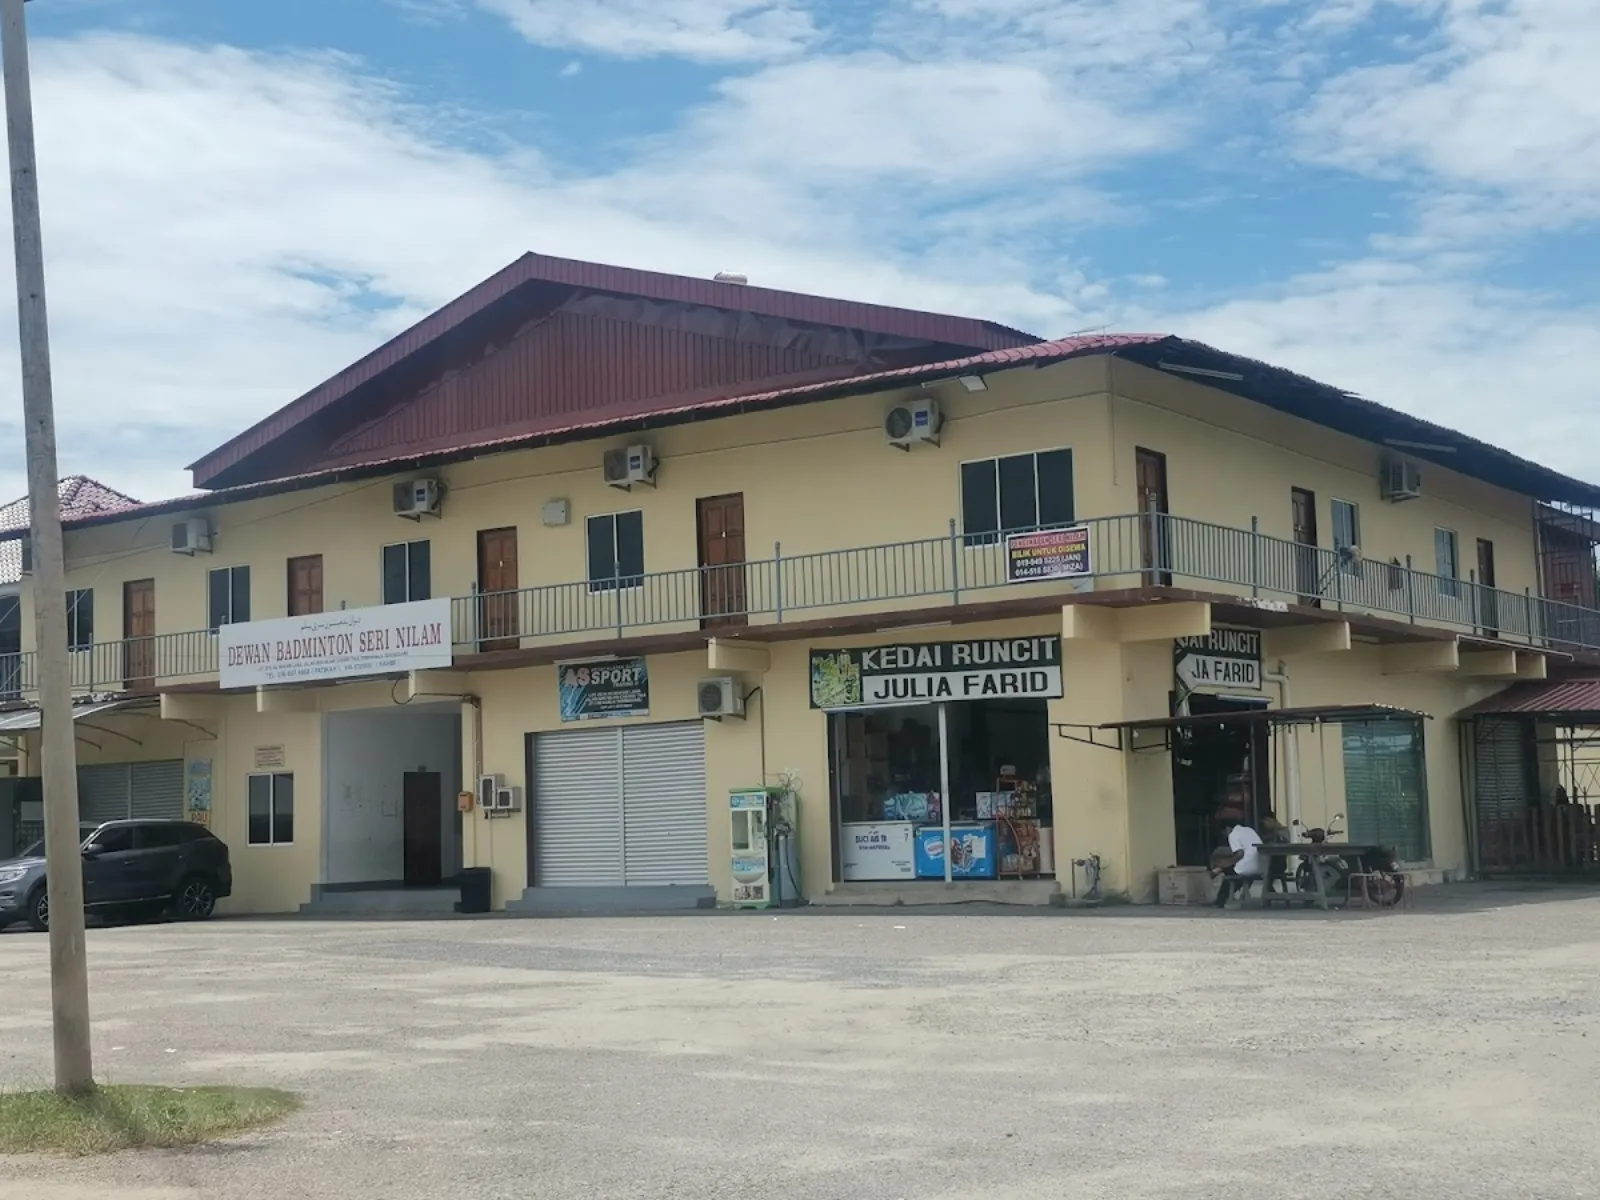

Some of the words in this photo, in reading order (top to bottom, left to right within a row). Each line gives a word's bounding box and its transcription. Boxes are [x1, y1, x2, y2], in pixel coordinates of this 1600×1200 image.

[1032, 546, 1057, 557] UNTUK
[228, 641, 270, 667] DEWAN
[276, 633, 353, 662] BADMINTON
[359, 628, 390, 653] SERI
[396, 622, 442, 649] NILAM
[861, 644, 942, 670] KEDAI
[952, 637, 1058, 666] RUNCIT
[1208, 629, 1259, 655] RUNCIT
[591, 667, 642, 685] SPORT
[874, 676, 952, 700] JULIA
[963, 670, 1048, 696] FARID
[1214, 660, 1254, 684] FARID
